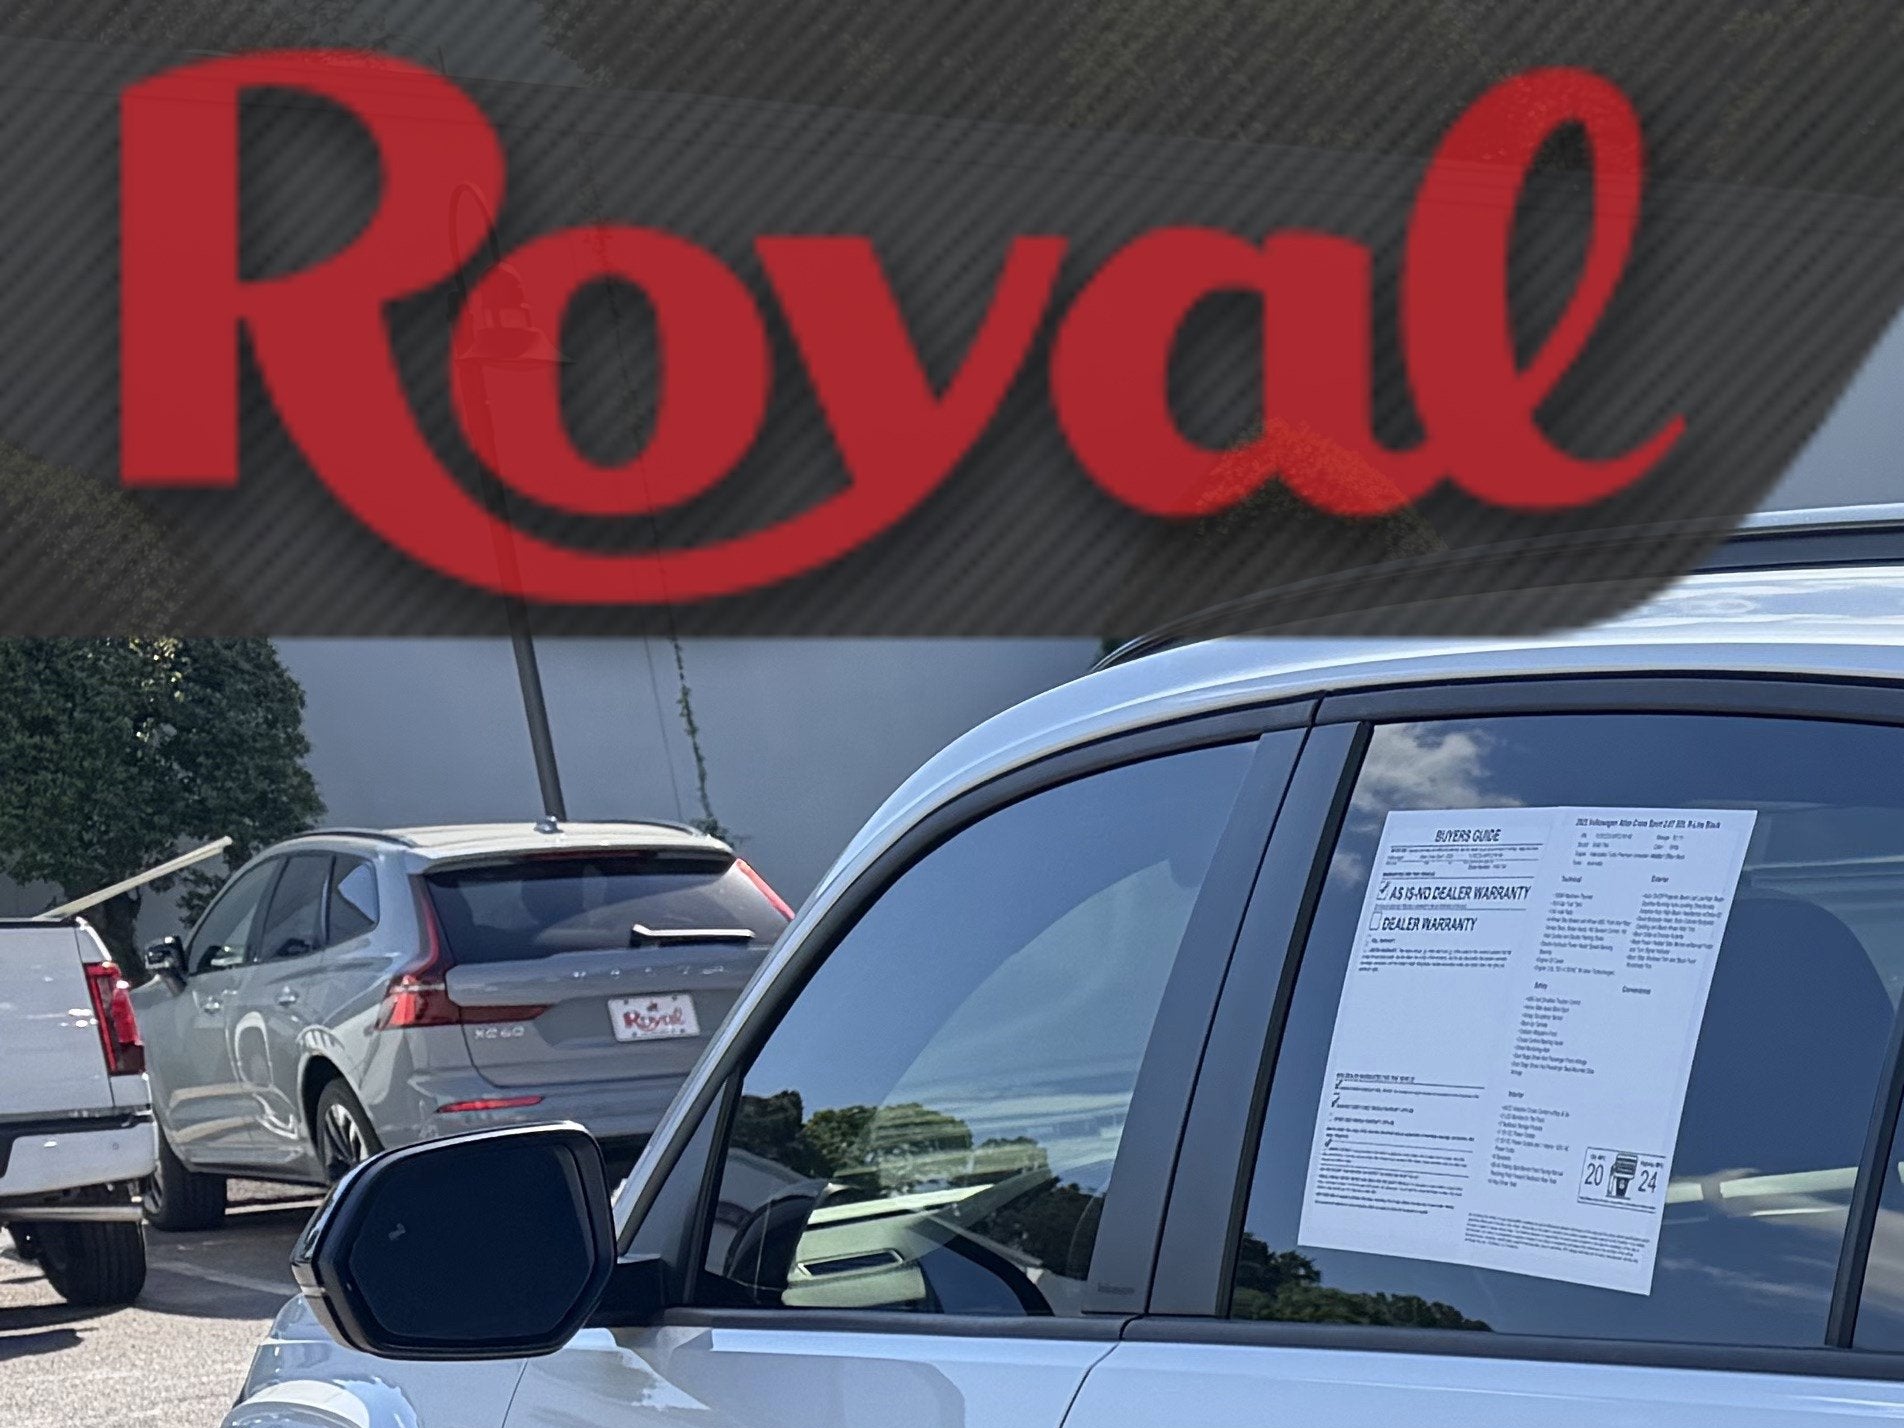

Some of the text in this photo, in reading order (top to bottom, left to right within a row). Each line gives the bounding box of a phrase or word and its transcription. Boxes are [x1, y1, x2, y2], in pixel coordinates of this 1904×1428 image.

[1435, 828, 1502, 843] BUYERS GUIDE
[1389, 886, 1404, 901] AS
[1432, 886, 1470, 901] DEALER
[1474, 886, 1532, 901] WARRANTY
[1382, 916, 1478, 932] DEALER WARRANTY
[1584, 1162, 1604, 1187] 20
[1637, 1169, 1658, 1194] 24
